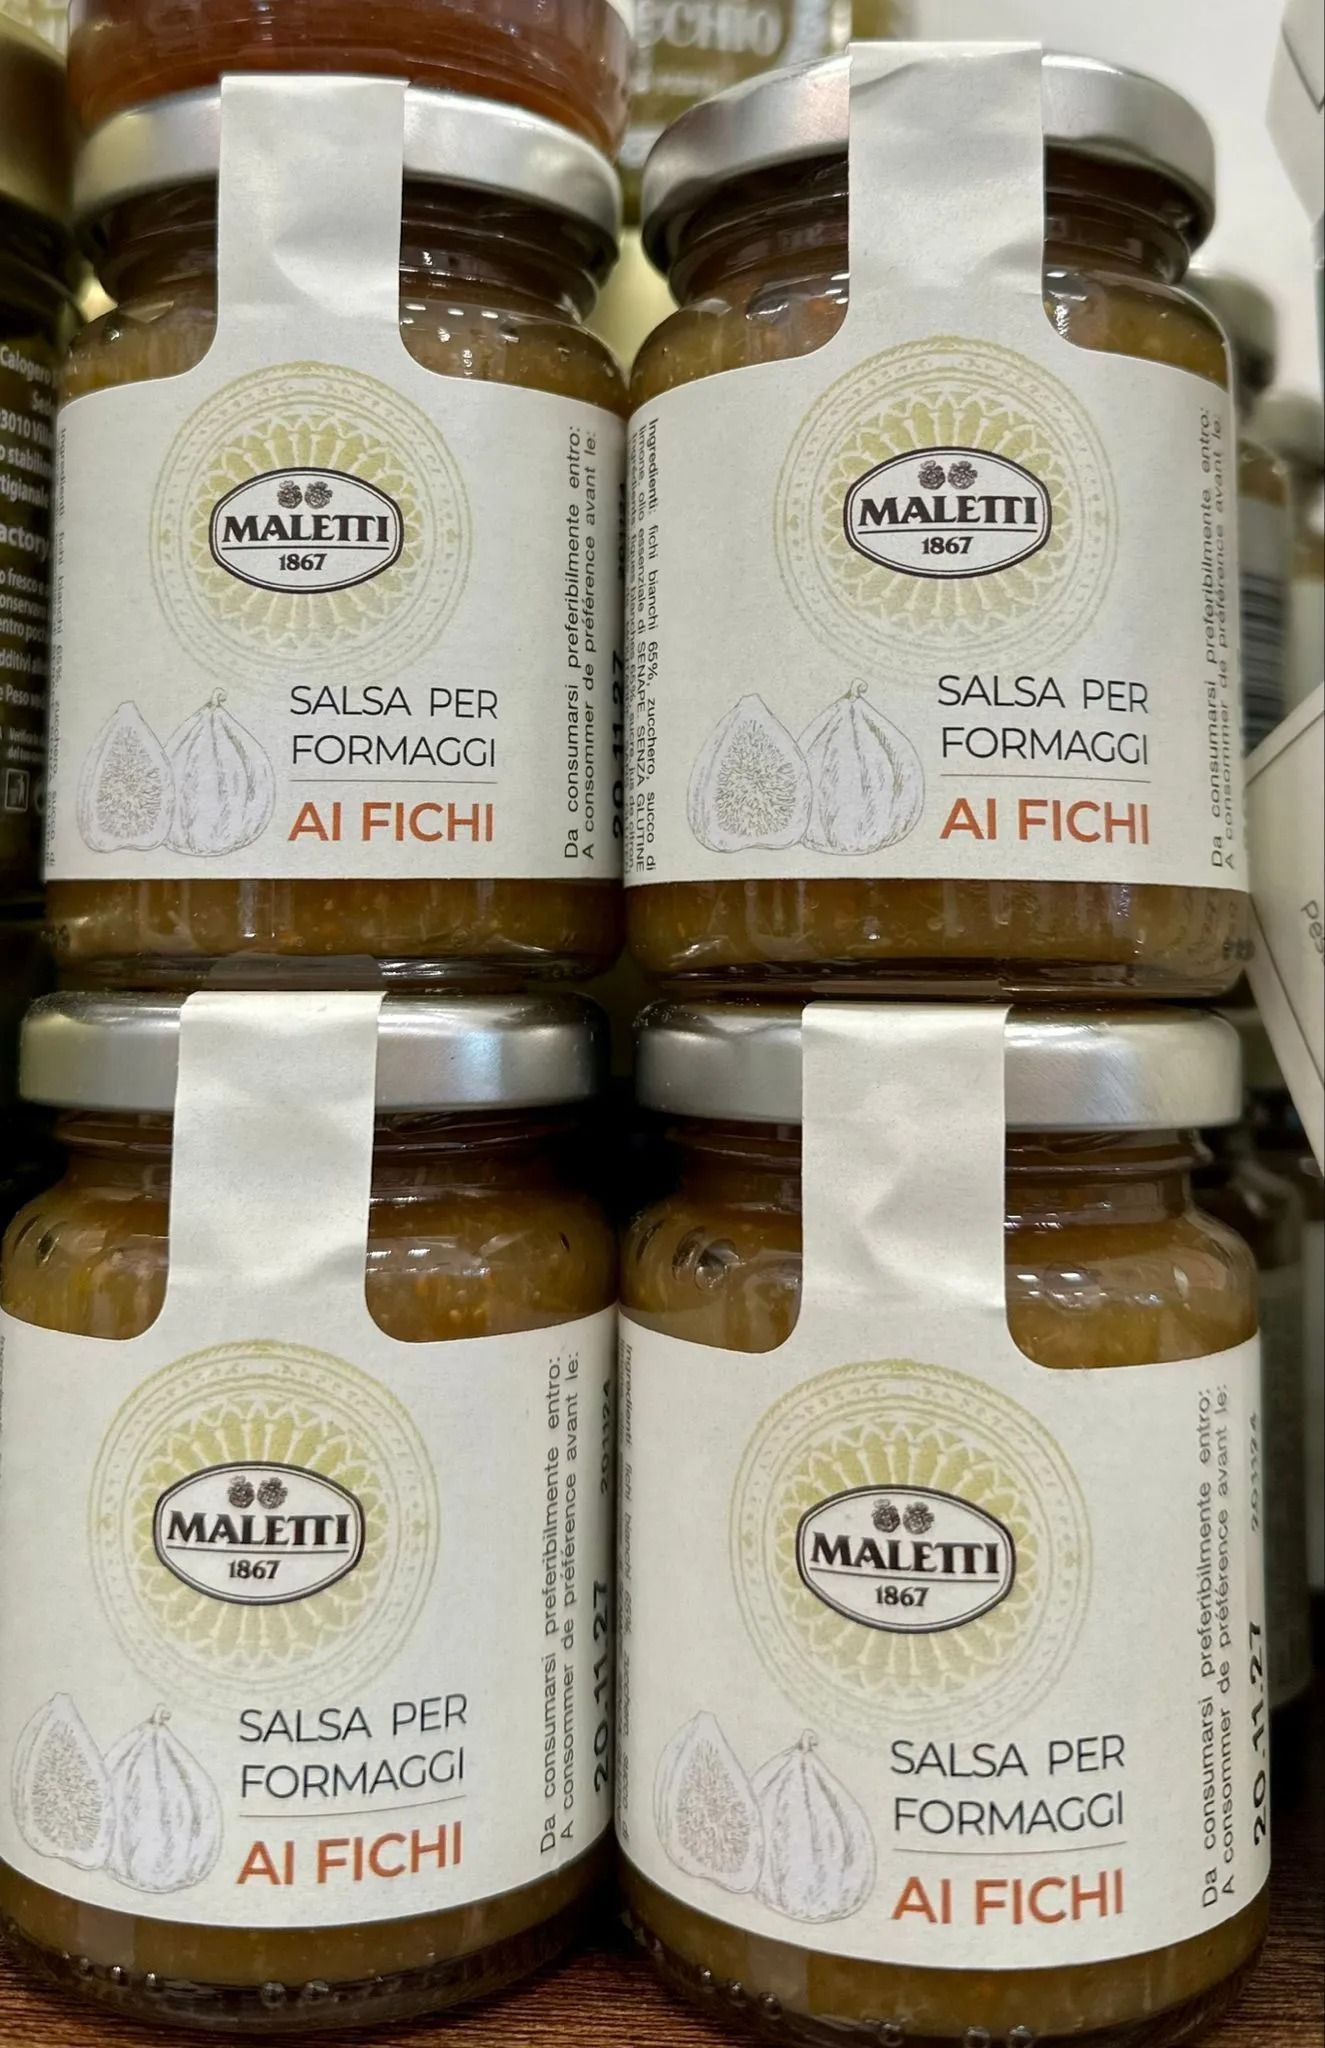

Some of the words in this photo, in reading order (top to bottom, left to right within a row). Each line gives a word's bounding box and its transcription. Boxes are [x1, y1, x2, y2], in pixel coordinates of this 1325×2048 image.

[0, 345, 51, 386] Calogero
[583, 431, 596, 457] le:
[1198, 407, 1211, 473] entro:
[1211, 414, 1222, 440] le:
[567, 424, 580, 489] entro:
[646, 418, 660, 512] Ingredienti:
[583, 466, 596, 526] avant
[638, 491, 647, 521] olio
[1212, 451, 1225, 513] avant
[221, 513, 390, 543] MALETTI
[858, 495, 1038, 526] MALETTI
[278, 552, 328, 572] 1867
[648, 524, 660, 561] fichi
[921, 535, 974, 557] 1867
[8, 567, 38, 594] fresco
[563, 503, 582, 669] preferibilmente
[638, 527, 647, 613] essenziale
[1200, 488, 1218, 664] preferibilmente
[1214, 524, 1230, 649] préférence
[582, 536, 597, 653] préférence
[648, 569, 660, 631] bianchi
[638, 619, 647, 635] di
[582, 663, 595, 691] de
[646, 640, 659, 687] 65%,
[1216, 660, 1228, 689] de
[6, 683, 30, 706] Peso
[290, 684, 412, 717] SALSA
[428, 687, 499, 720] PER
[937, 674, 1067, 710] SALSA
[1082, 679, 1149, 715] PER
[291, 733, 497, 769] FORMAGGI
[564, 683, 579, 813] consumarsi
[637, 724, 646, 786] SENZA
[646, 697, 658, 780] zucchero,
[941, 726, 1149, 766] FORMAGGI
[1203, 680, 1221, 818] consumarsi
[583, 702, 595, 832] consommer
[1221, 700, 1234, 840] consommer
[288, 801, 343, 843] AI
[362, 801, 495, 843] FICHI
[636, 792, 646, 873] GLUTINE
[647, 791, 656, 844] succo
[940, 797, 998, 842] AI
[1018, 798, 1150, 846] FICHI
[564, 828, 579, 859] Da
[582, 842, 595, 860] A
[647, 855, 657, 872] di
[1211, 834, 1225, 869] Da
[1224, 852, 1235, 871] A
[565, 1350, 579, 1381] le:
[545, 1356, 561, 1430] entro:
[1214, 1383, 1228, 1415] le:
[563, 1392, 577, 1461] avant
[1196, 1387, 1212, 1464] entro:
[1214, 1428, 1229, 1497] avant
[1249, 1411, 1260, 1534] 201124
[166, 1510, 350, 1547] MALETTI
[543, 1446, 560, 1636] preferibilmente
[561, 1473, 577, 1607] préférence
[227, 1559, 281, 1581] 1867
[811, 1532, 1000, 1575] MALETTI
[874, 1585, 928, 1608] 1867
[1197, 1480, 1215, 1677] preferibilmente
[1215, 1508, 1233, 1649] préférence
[561, 1619, 575, 1650] de
[593, 1579, 609, 1793] 20.11.27
[1217, 1660, 1231, 1694] de
[239, 1705, 372, 1743] SALSA
[391, 1693, 468, 1732] PER
[540, 1652, 557, 1799] consumarsi
[561, 1663, 575, 1810] consommer
[1248, 1620, 1267, 1847] 20.11.27
[241, 1746, 466, 1799] FORMAGGI
[890, 1739, 1028, 1777] SALSA
[1047, 1733, 1126, 1775] PER
[1198, 1695, 1216, 1851] consumarsi
[1219, 1706, 1235, 1864] consommer
[540, 1814, 557, 1854] Da
[560, 1819, 574, 1841] A
[894, 1790, 1124, 1836] FORMAGGI
[235, 1840, 295, 1886] AI
[317, 1820, 463, 1884] FICHI
[891, 1877, 953, 1924] AI
[975, 1867, 1125, 1925] FICHI
[1201, 1866, 1218, 1909] Da
[1220, 1874, 1235, 1895] A
